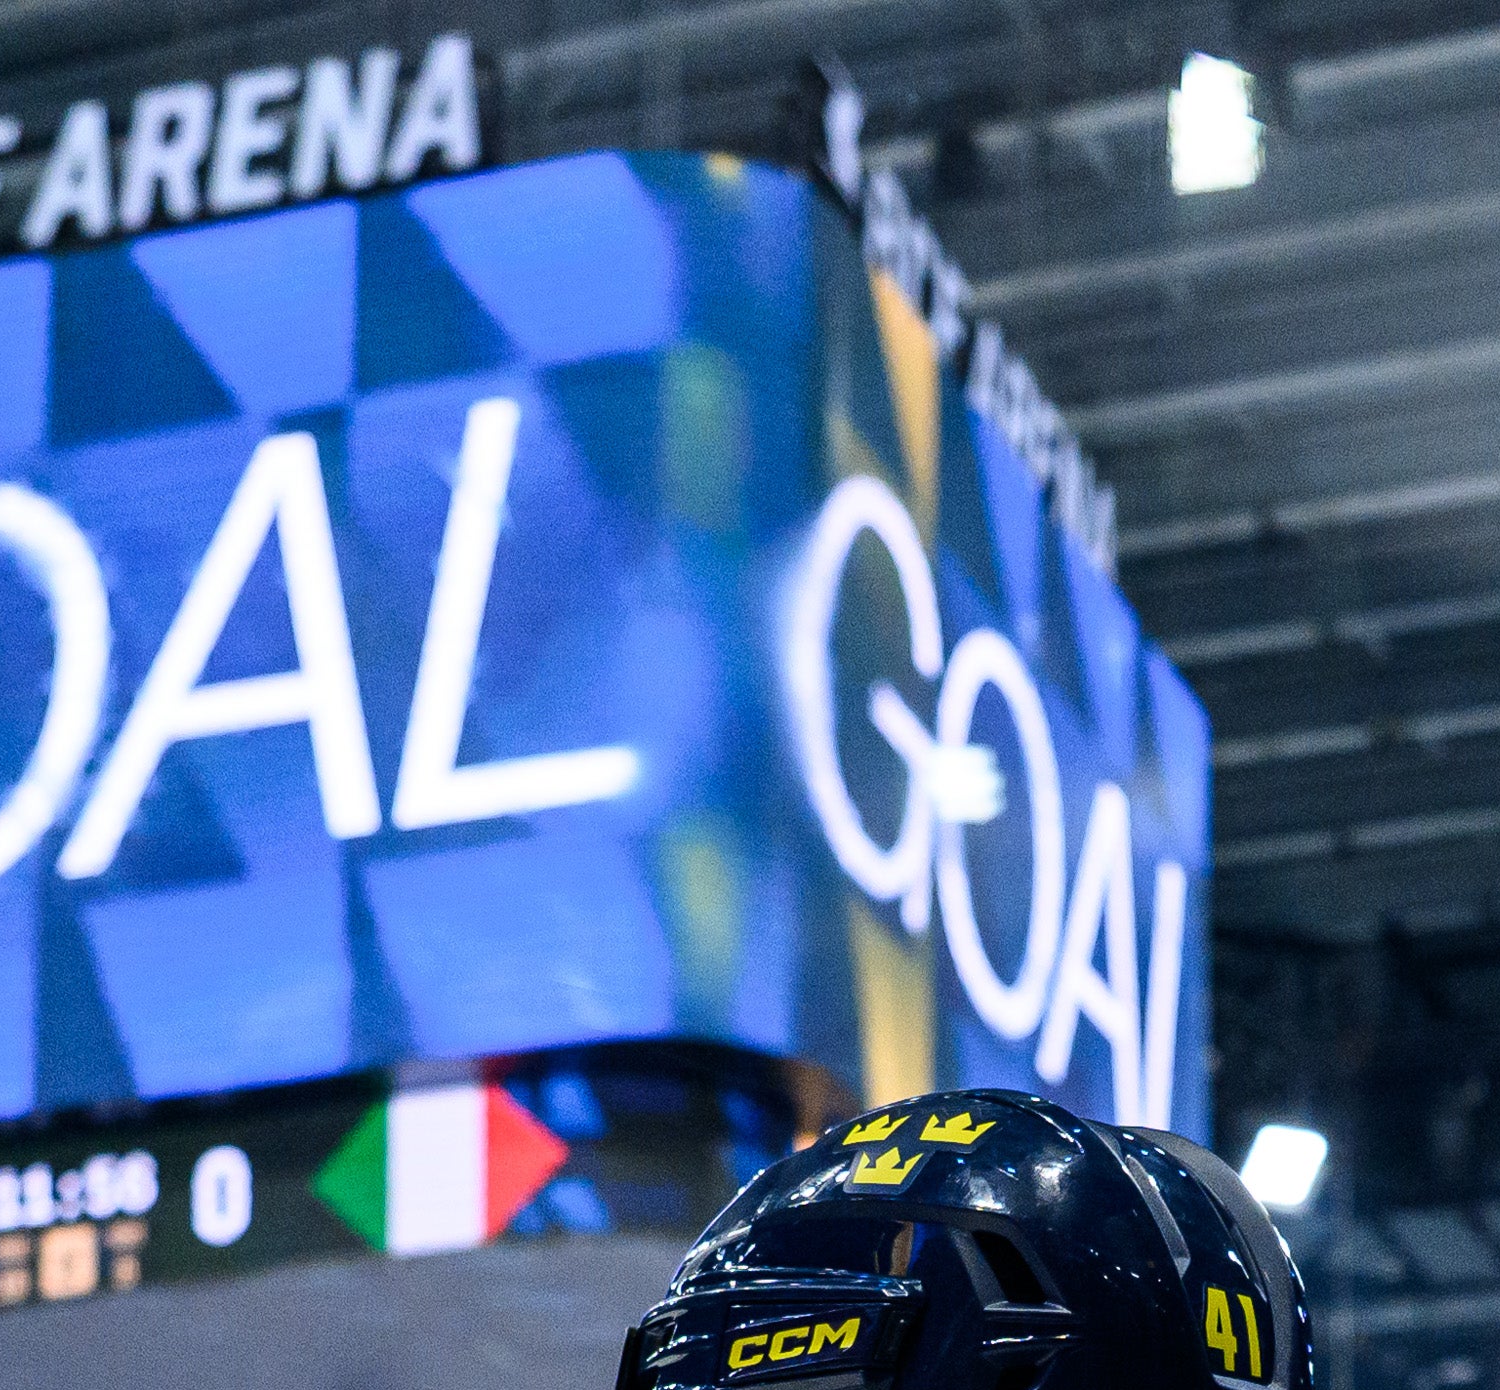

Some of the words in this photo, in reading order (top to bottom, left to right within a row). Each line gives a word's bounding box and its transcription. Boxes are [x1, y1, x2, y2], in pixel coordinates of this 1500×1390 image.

[20, 30, 482, 248] ARENA
[190, 1144, 254, 1247] 0
[727, 1317, 861, 1370] CCM
[1205, 1286, 1262, 1378] 41
